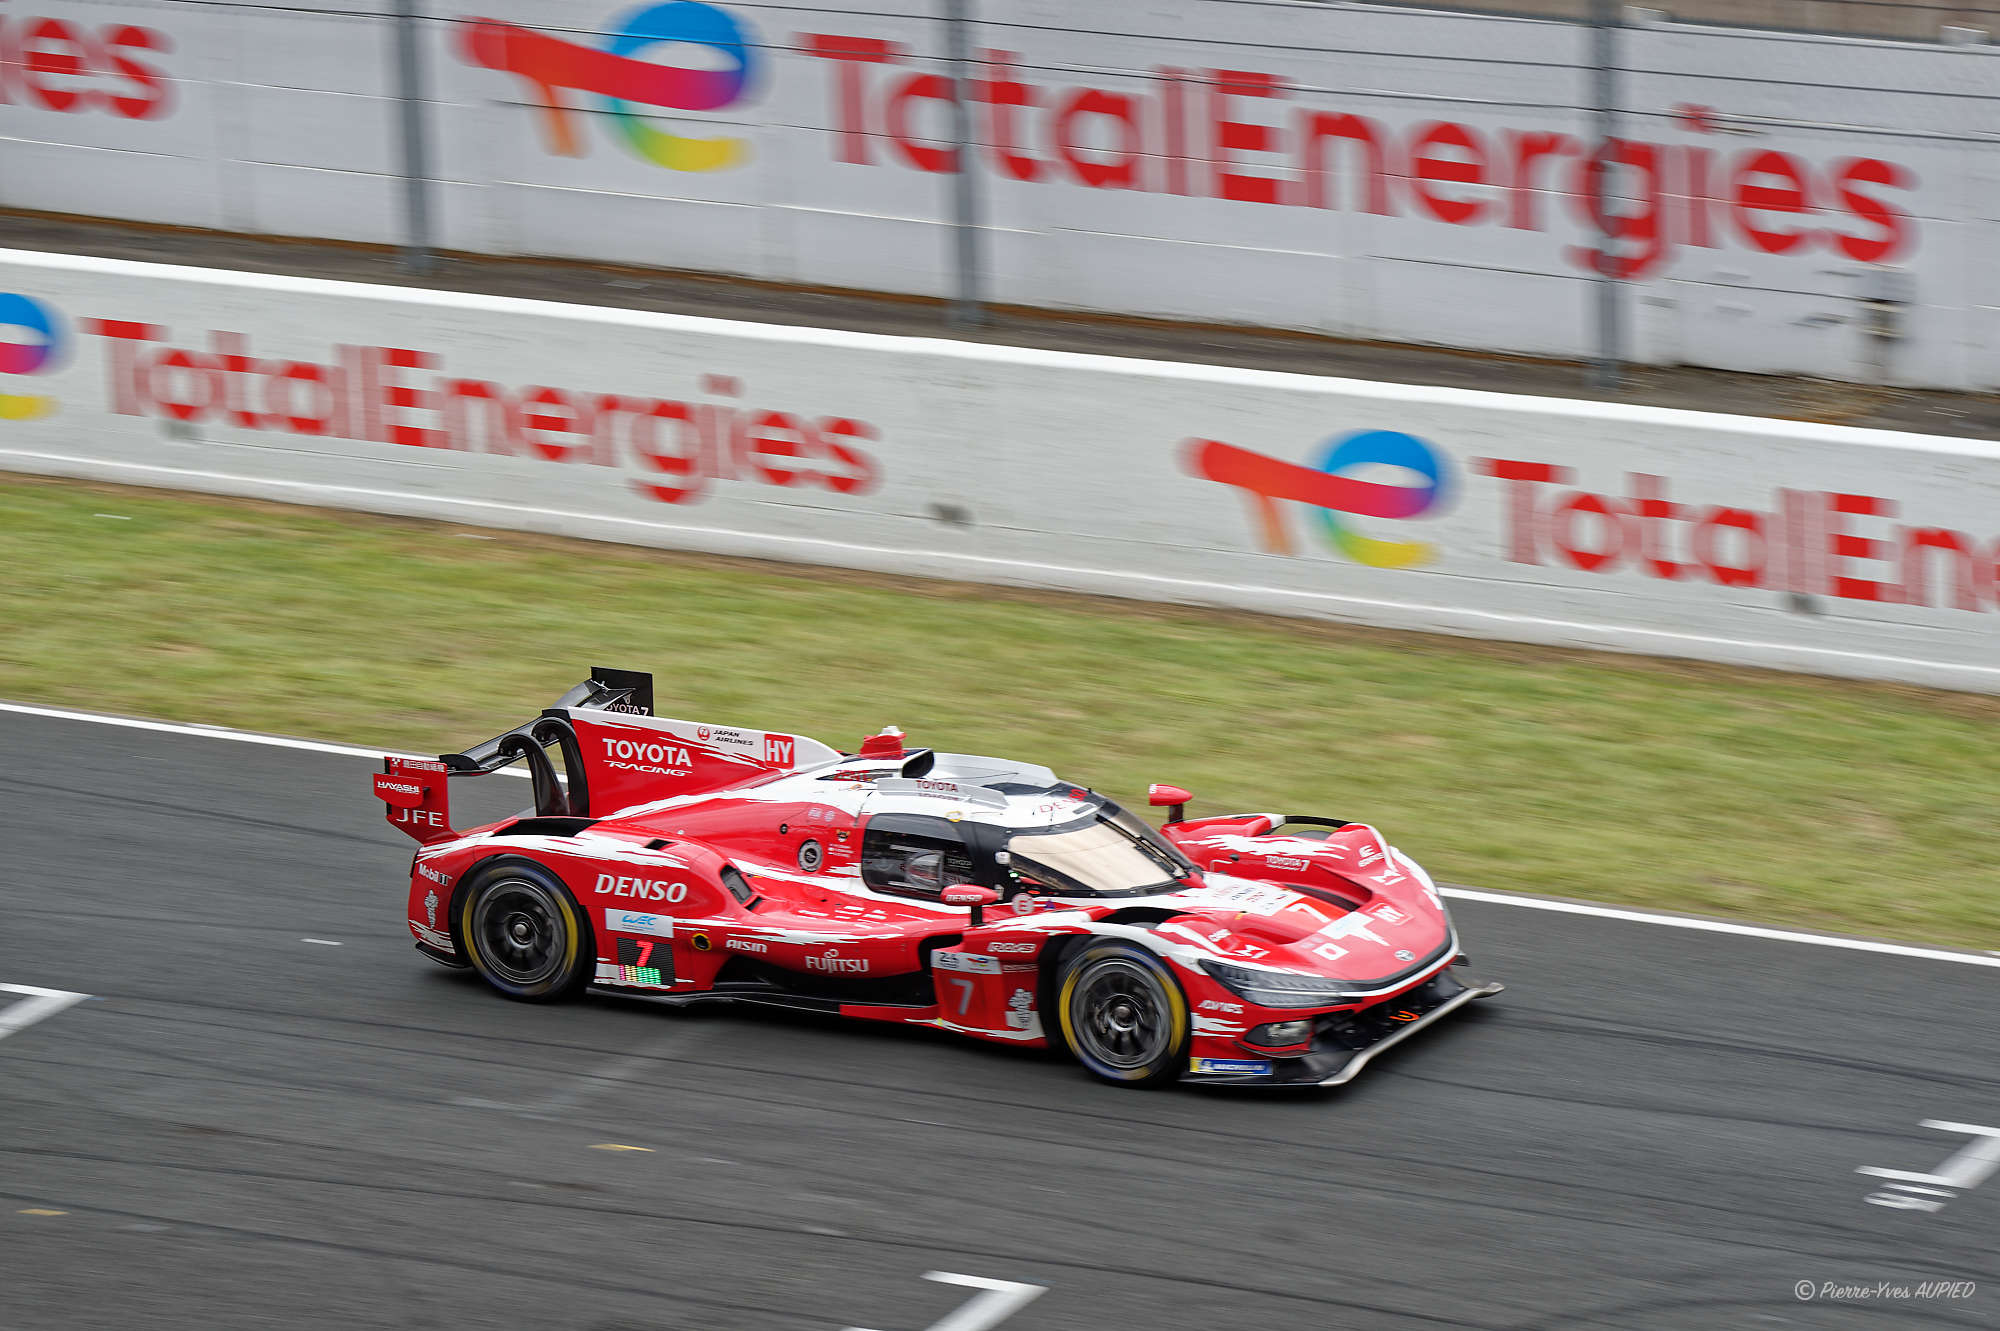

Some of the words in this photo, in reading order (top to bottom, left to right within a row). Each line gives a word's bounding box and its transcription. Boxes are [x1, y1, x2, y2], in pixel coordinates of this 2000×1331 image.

[788, 31, 1916, 281] TotalEnergies
[80, 317, 880, 505] TotalEnergies
[1474, 457, 2000, 613] TotalEn
[713, 730, 740, 738] JAPAN
[602, 738, 692, 767] TOYOTA
[766, 740, 793, 764] HY
[603, 760, 693, 777] RACING
[377, 781, 419, 793] HAYASHI
[916, 780, 958, 792] TOYOTA
[396, 808, 444, 827] JFE
[594, 873, 688, 903] DENSO
[636, 940, 654, 967] 7
[805, 954, 869, 973] FUJITSU
[950, 978, 974, 1015] 7
